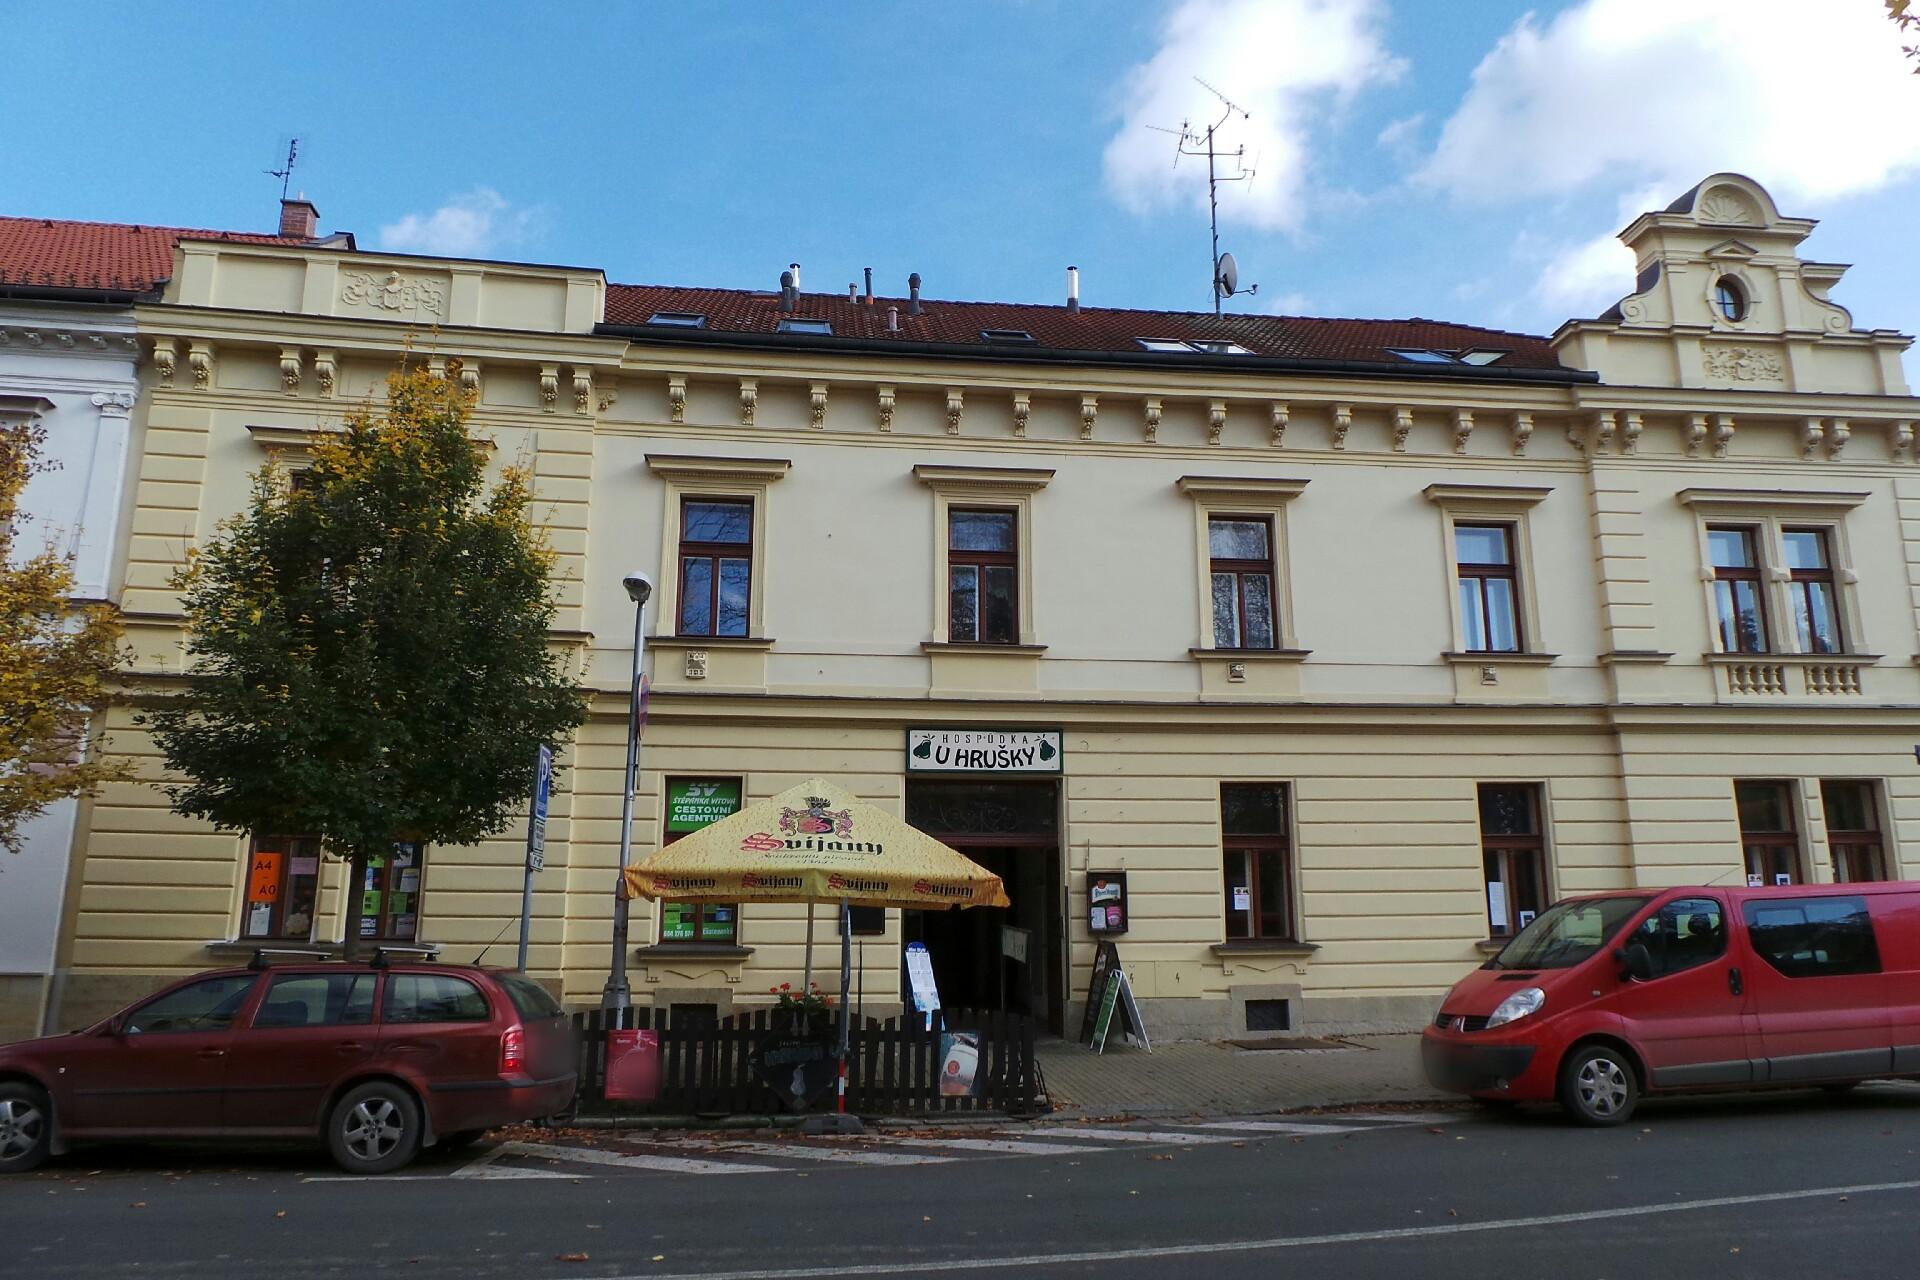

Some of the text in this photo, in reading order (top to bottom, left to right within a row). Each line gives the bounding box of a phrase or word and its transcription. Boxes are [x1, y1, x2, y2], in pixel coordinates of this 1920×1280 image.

[935, 745, 1035, 768] U HRUŠKY
[539, 756, 549, 797] P
[672, 814, 727, 822] AGENTUR
[674, 806, 731, 814] CESTOVNÍ
[740, 832, 883, 855] Svijany
[255, 861, 272, 870] A4
[653, 874, 716, 890] Svijany
[742, 873, 803, 889] Svijany
[827, 873, 889, 892] Svijany
[912, 879, 973, 898] Svijany
